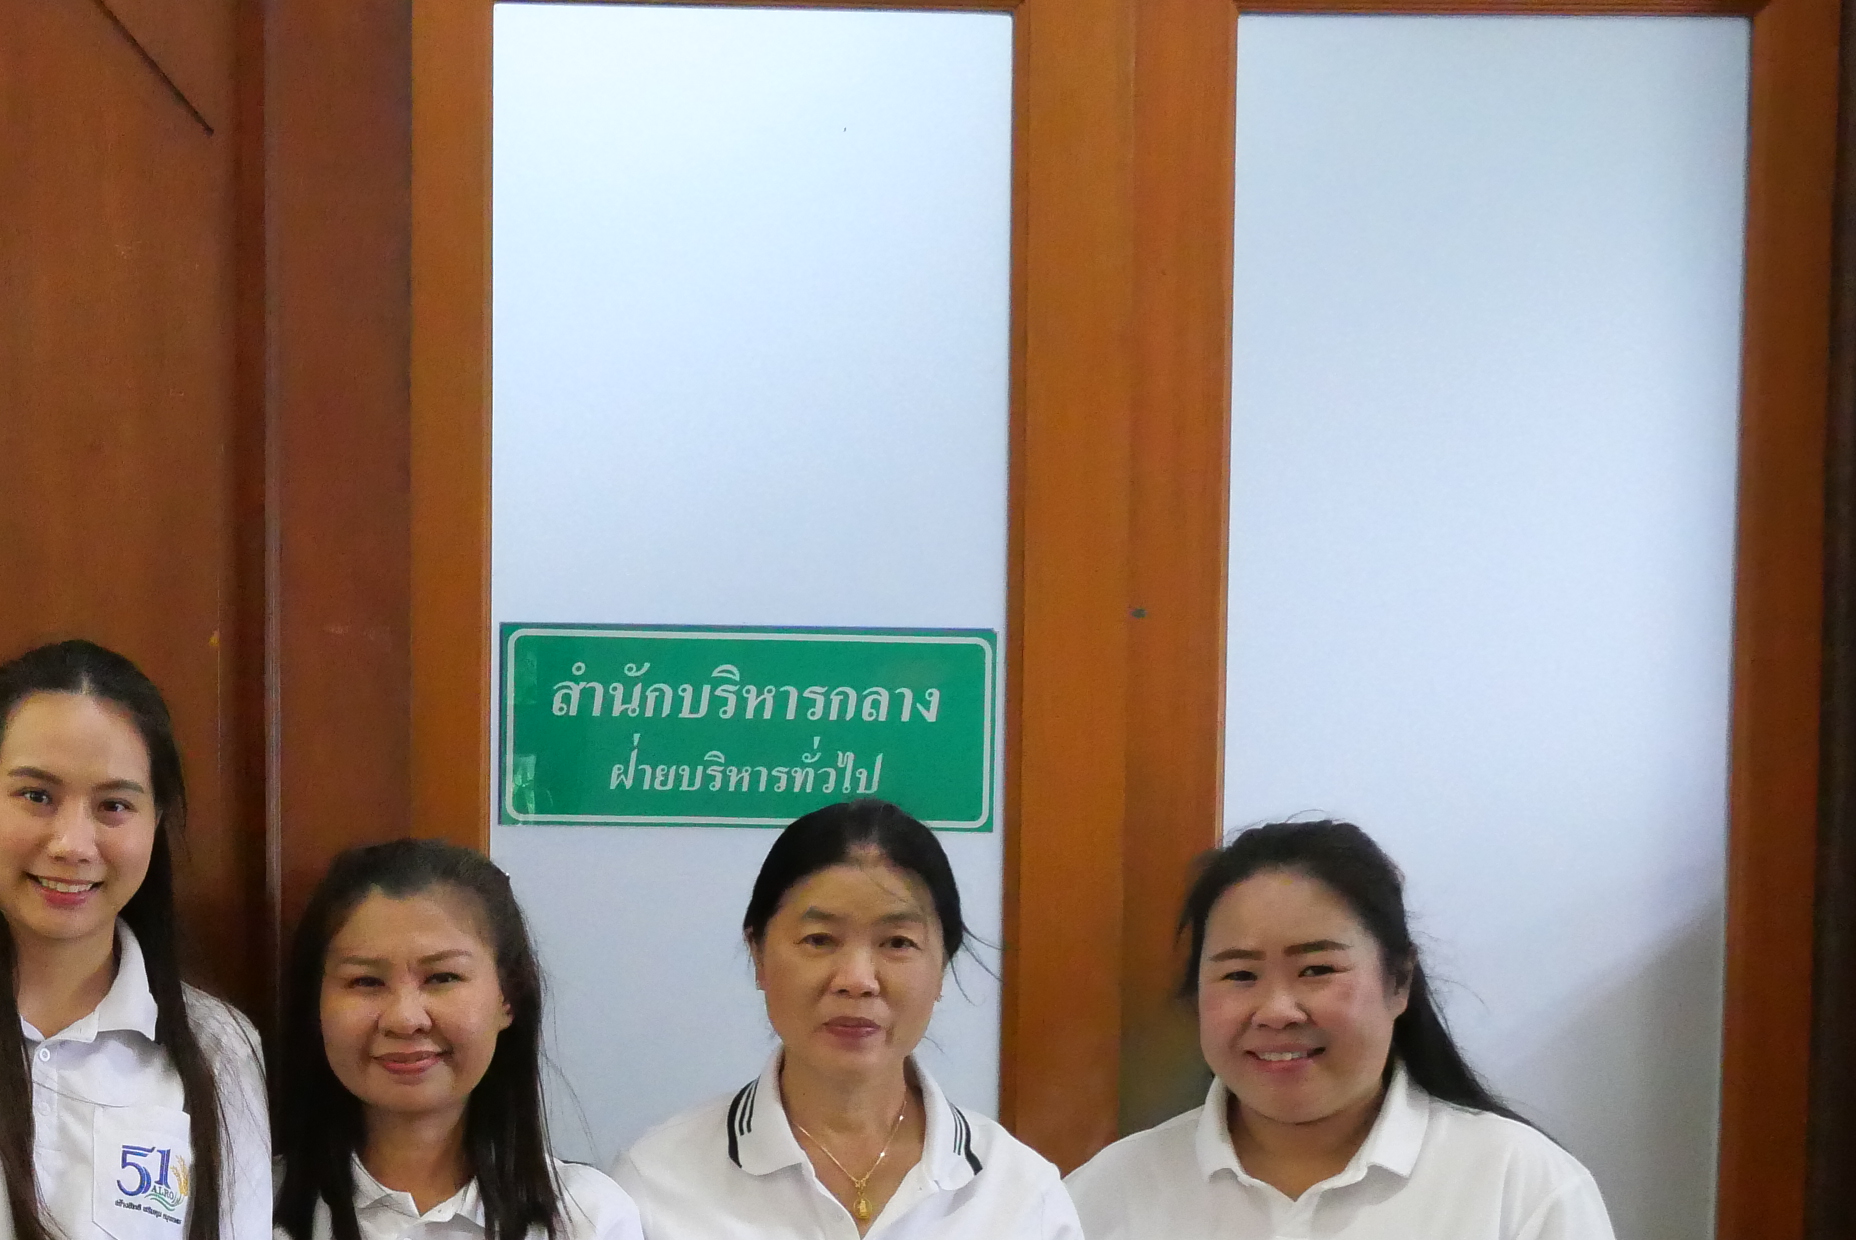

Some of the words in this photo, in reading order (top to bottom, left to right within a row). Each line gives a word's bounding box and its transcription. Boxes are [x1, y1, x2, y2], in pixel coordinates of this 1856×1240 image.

[551, 662, 941, 722] สำนักบริหารกลาง
[610, 734, 883, 794] ฝ่ายบริหารทั่วไป
[116, 1145, 171, 1196] 51
[151, 1185, 175, 1200] ALRO
